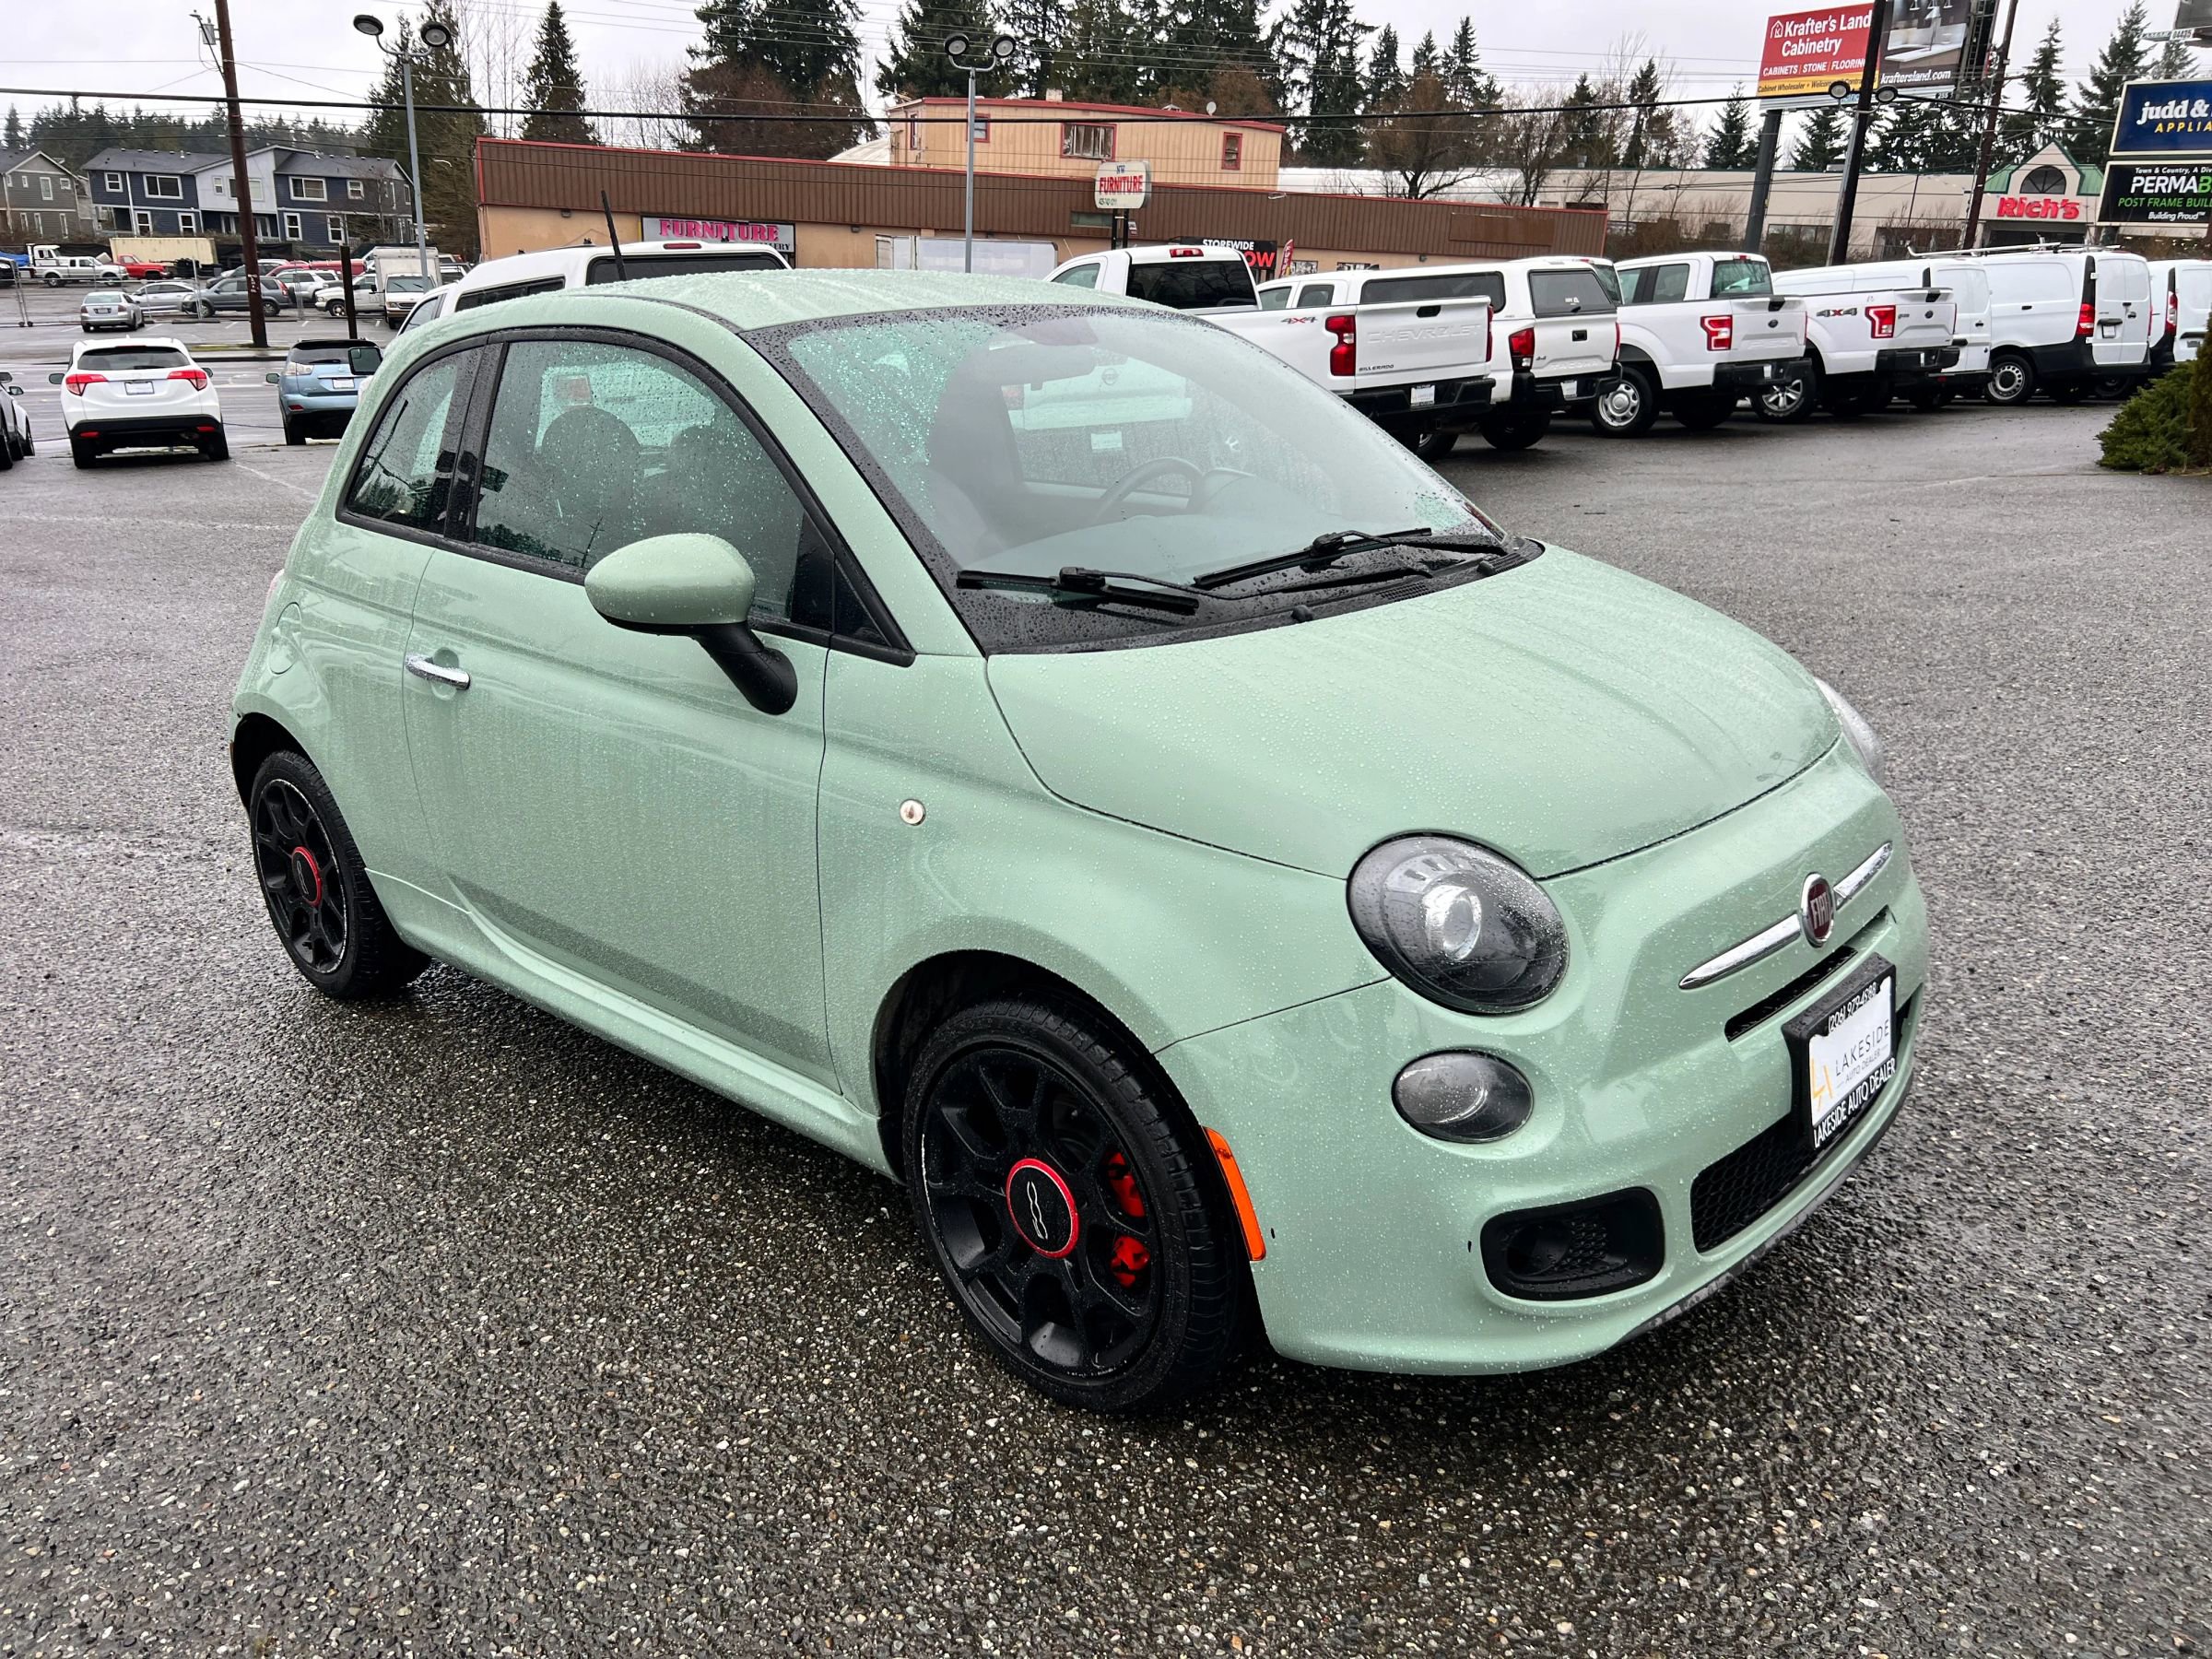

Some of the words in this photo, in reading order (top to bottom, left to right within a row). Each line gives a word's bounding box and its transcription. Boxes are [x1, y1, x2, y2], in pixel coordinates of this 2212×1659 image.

[1784, 15, 1837, 38] Krafter's
[1840, 10, 1873, 31] Land
[1782, 37, 1842, 57] Cabinetry
[1763, 65, 1798, 76] CABINETS
[1803, 62, 1828, 73] STONE
[1831, 58, 1865, 70] FLOORIN
[1880, 69, 1951, 84] kraftersland.com
[2136, 100, 2189, 125] judd
[2190, 99, 2210, 118] &
[2154, 121, 2212, 134] APPLIA
[1100, 175, 1143, 195] FURNITURE
[1996, 196, 2080, 220] Rich's
[2118, 197, 2146, 207] POST
[2147, 197, 2183, 207] FRAME
[2147, 211, 2176, 221] Building
[659, 219, 780, 241] FURNITURE
[1203, 239, 1254, 251] STOREWIDE
[1244, 251, 1276, 268] OW
[1810, 891, 1830, 930] FIAT
[1835, 1019, 1889, 1076] LAKESIDE
[1845, 1065, 1860, 1083] AUTO
[1862, 1053, 1880, 1071] DEALER
[1814, 1107, 1847, 1148] LAKESIDE
[1847, 1082, 1869, 1114] AUTO
[1869, 1058, 1896, 1092] DEALER
